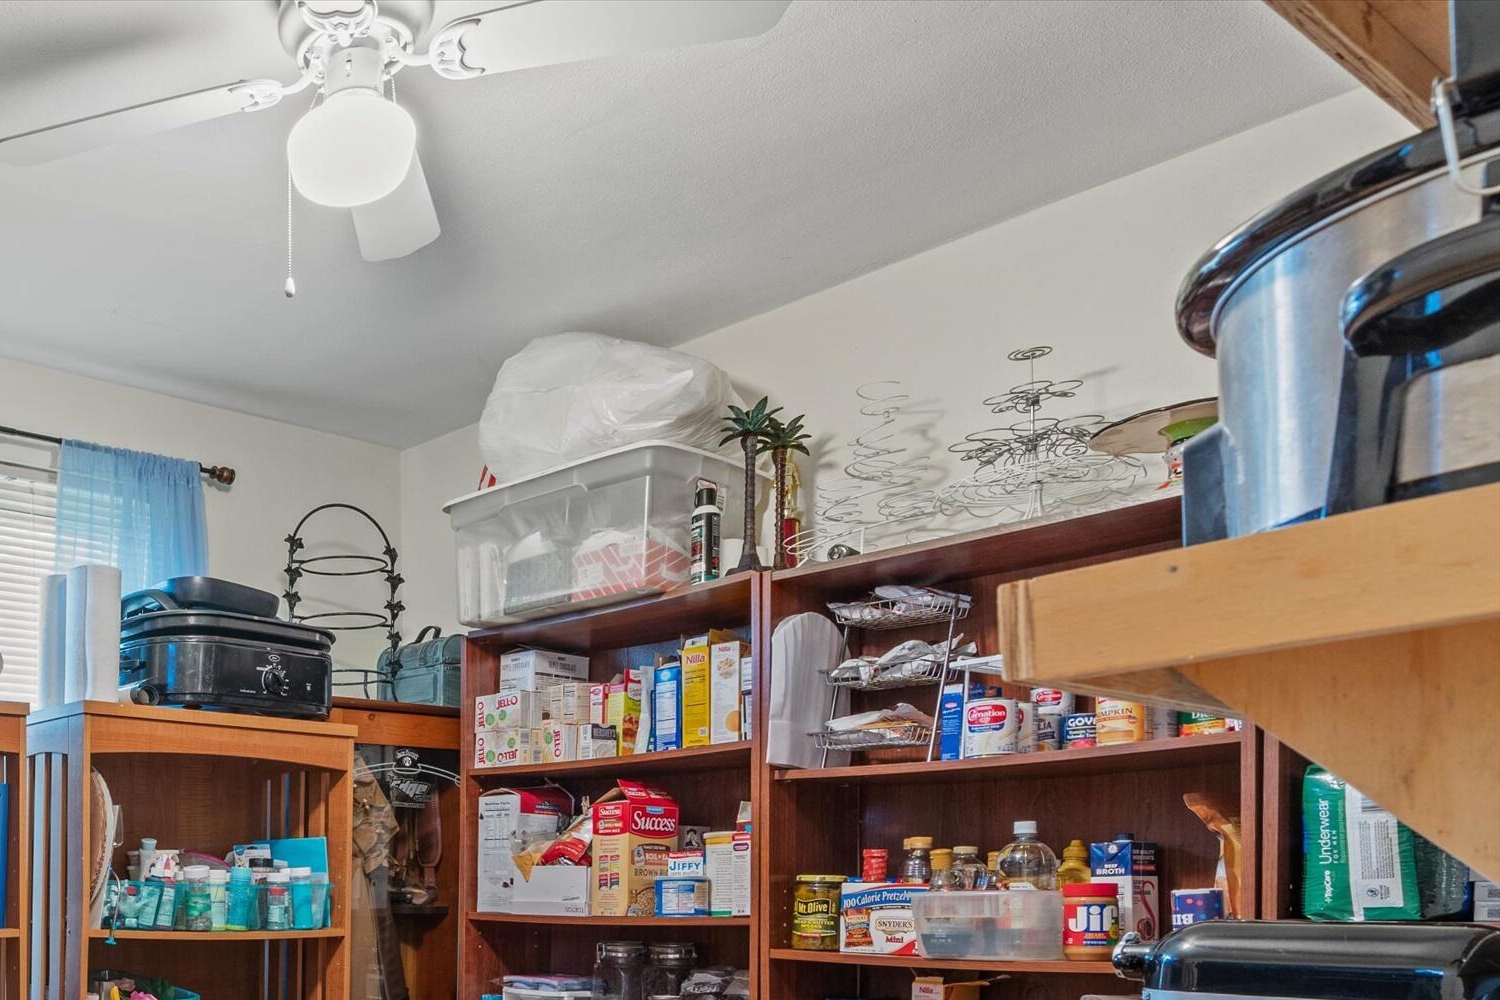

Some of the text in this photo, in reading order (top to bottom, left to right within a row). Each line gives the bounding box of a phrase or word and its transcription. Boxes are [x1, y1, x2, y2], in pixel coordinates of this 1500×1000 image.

[686, 654, 705, 665] Nilla
[496, 695, 518, 710] JELL-O
[477, 701, 486, 729] JELL-O
[968, 708, 1007, 722] Carnation
[553, 729, 562, 758] JELL-O
[478, 737, 486, 765] JELL-O
[497, 749, 519, 763] JELL-O
[632, 810, 676, 832] Success
[1318, 798, 1332, 865] Underwear
[669, 861, 701, 871] JIFFY
[807, 901, 828, 913] Olive
[843, 898, 857, 908] 100
[857, 892, 881, 905] Calorie
[877, 919, 913, 929] SNYDER'S
[1068, 904, 1118, 932] Jif
[885, 935, 904, 943] Mini
[918, 986, 934, 994] Nilla
